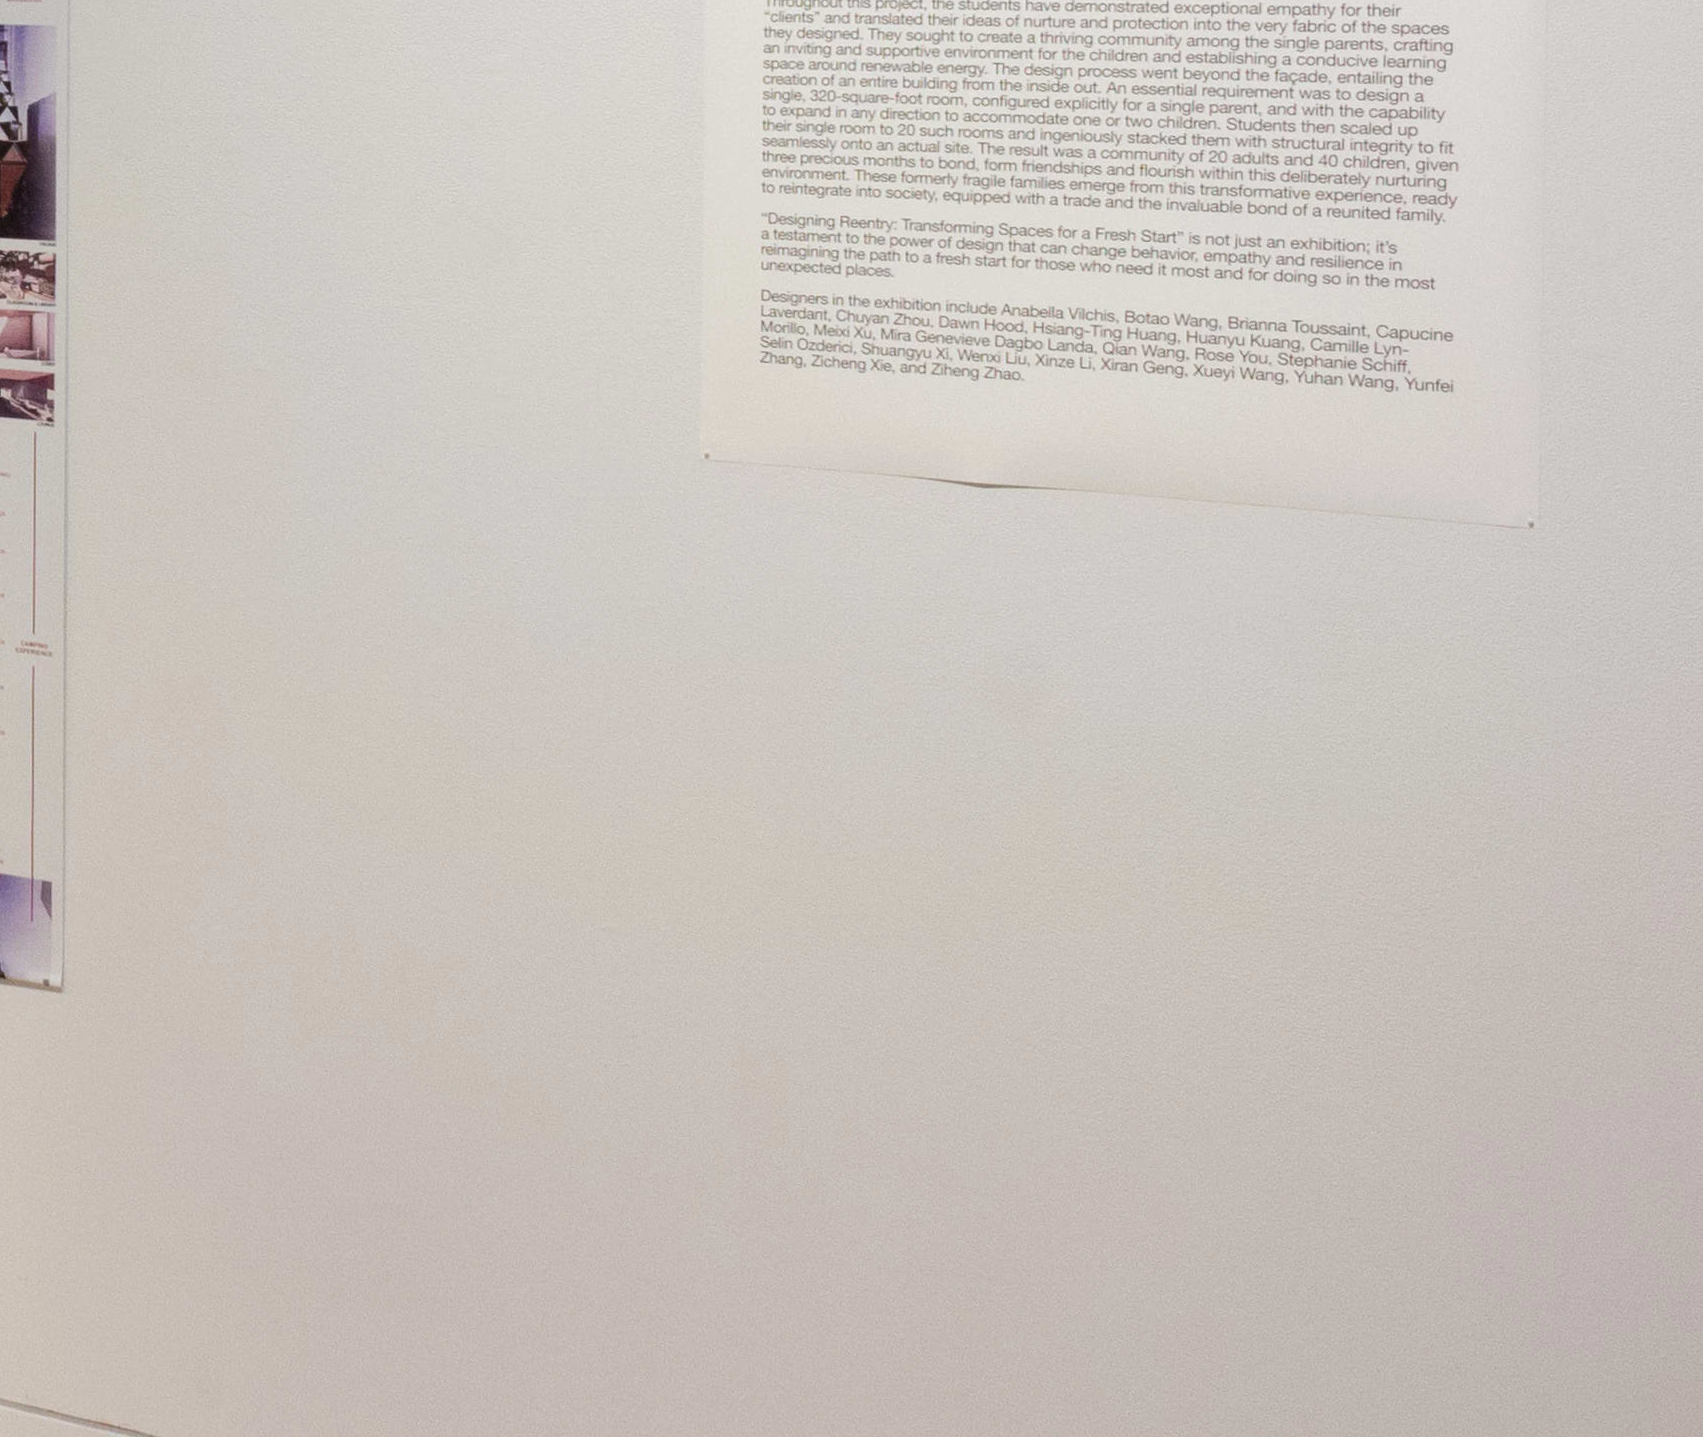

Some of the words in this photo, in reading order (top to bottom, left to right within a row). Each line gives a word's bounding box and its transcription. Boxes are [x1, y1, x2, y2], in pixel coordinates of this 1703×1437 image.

[1064, 0, 1170, 13] demonstrated
[1173, 1, 1263, 16] exceptional
[1266, 3, 1336, 18] empathy
[1340, 2, 1363, 16] for
[1366, 3, 1402, 16] their
[760, 290, 829, 307] Designers
[832, 293, 845, 307] in
[848, 294, 871, 308] the
[874, 297, 942, 312] exhibition
[945, 300, 998, 315] include
[1000, 303, 1064, 319] Anabella
[1067, 307, 1120, 324] Vilchis,
[1124, 309, 1170, 325] Botao
[1174, 313, 1223, 330] Wang,
[1227, 315, 1288, 331] Brianna
[1291, 319, 1370, 338] Toussaint,
[1375, 324, 1454, 342] Capucine
[760, 306, 832, 322] Laverdant,
[835, 310, 890, 326] Chuyan
[892, 313, 934, 329] Zhou,
[938, 315, 980, 330] Dawn
[983, 318, 1028, 335] Hood,
[1032, 321, 1123, 341] Hsiang-Ting
[1126, 326, 1181, 345] Huang,
[1186, 330, 1246, 348] Huanyu
[1249, 333, 1305, 352] Kuang,
[1309, 337, 1370, 353] Camille
[1373, 340, 1409, 357] Lyn-
